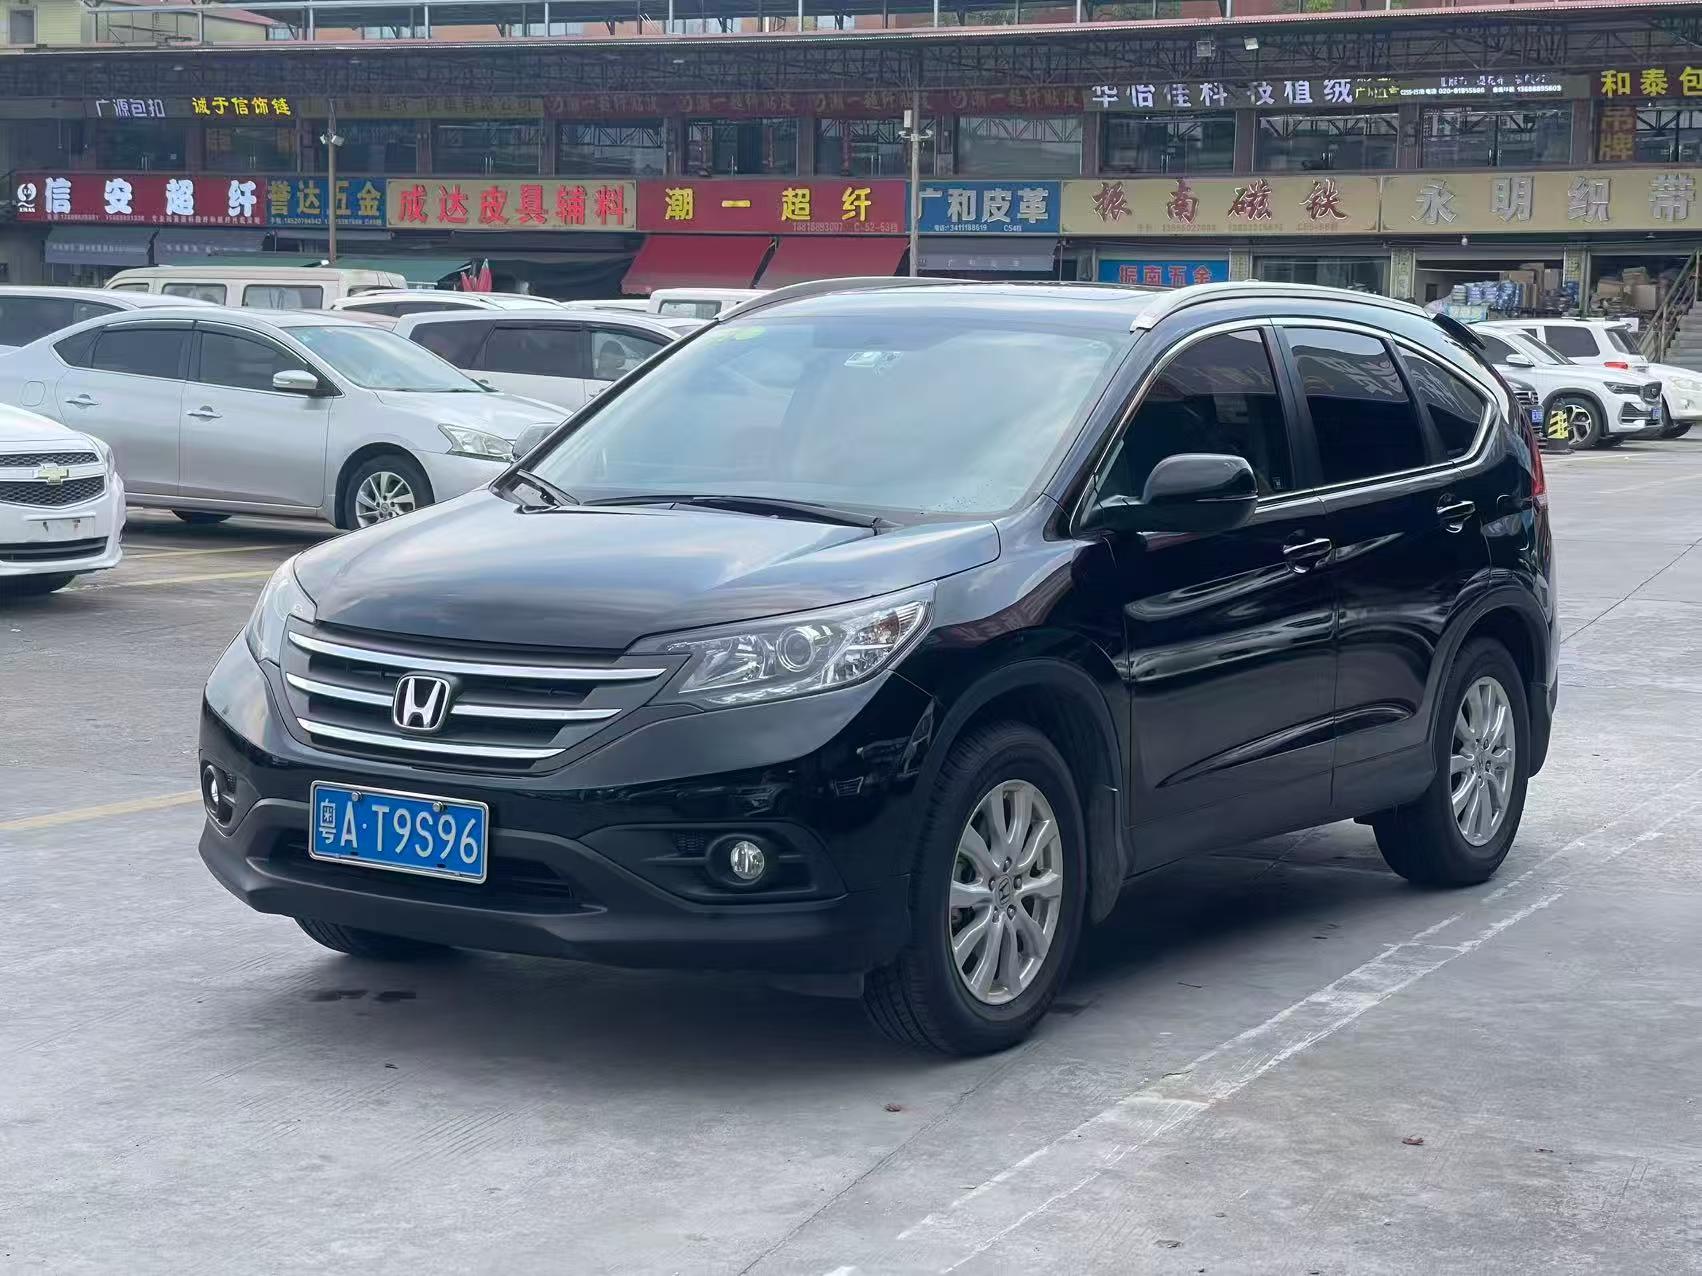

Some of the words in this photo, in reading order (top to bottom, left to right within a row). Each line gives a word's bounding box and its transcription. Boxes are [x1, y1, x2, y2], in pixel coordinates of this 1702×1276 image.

[1600, 65, 1702, 98] 和泰包
[95, 98, 166, 118] 广源包扣
[191, 96, 292, 115] 诚于信饰链
[45, 177, 258, 217] 信安超纤
[397, 183, 629, 226] 成达皮具辅料
[664, 186, 873, 222] 潮一超纤
[917, 186, 1050, 224] 广和皮革
[1091, 177, 1349, 224] 振南磁铁
[1410, 174, 1697, 225] 永明织带
[318, 798, 479, 865] 粤A·T9S96
